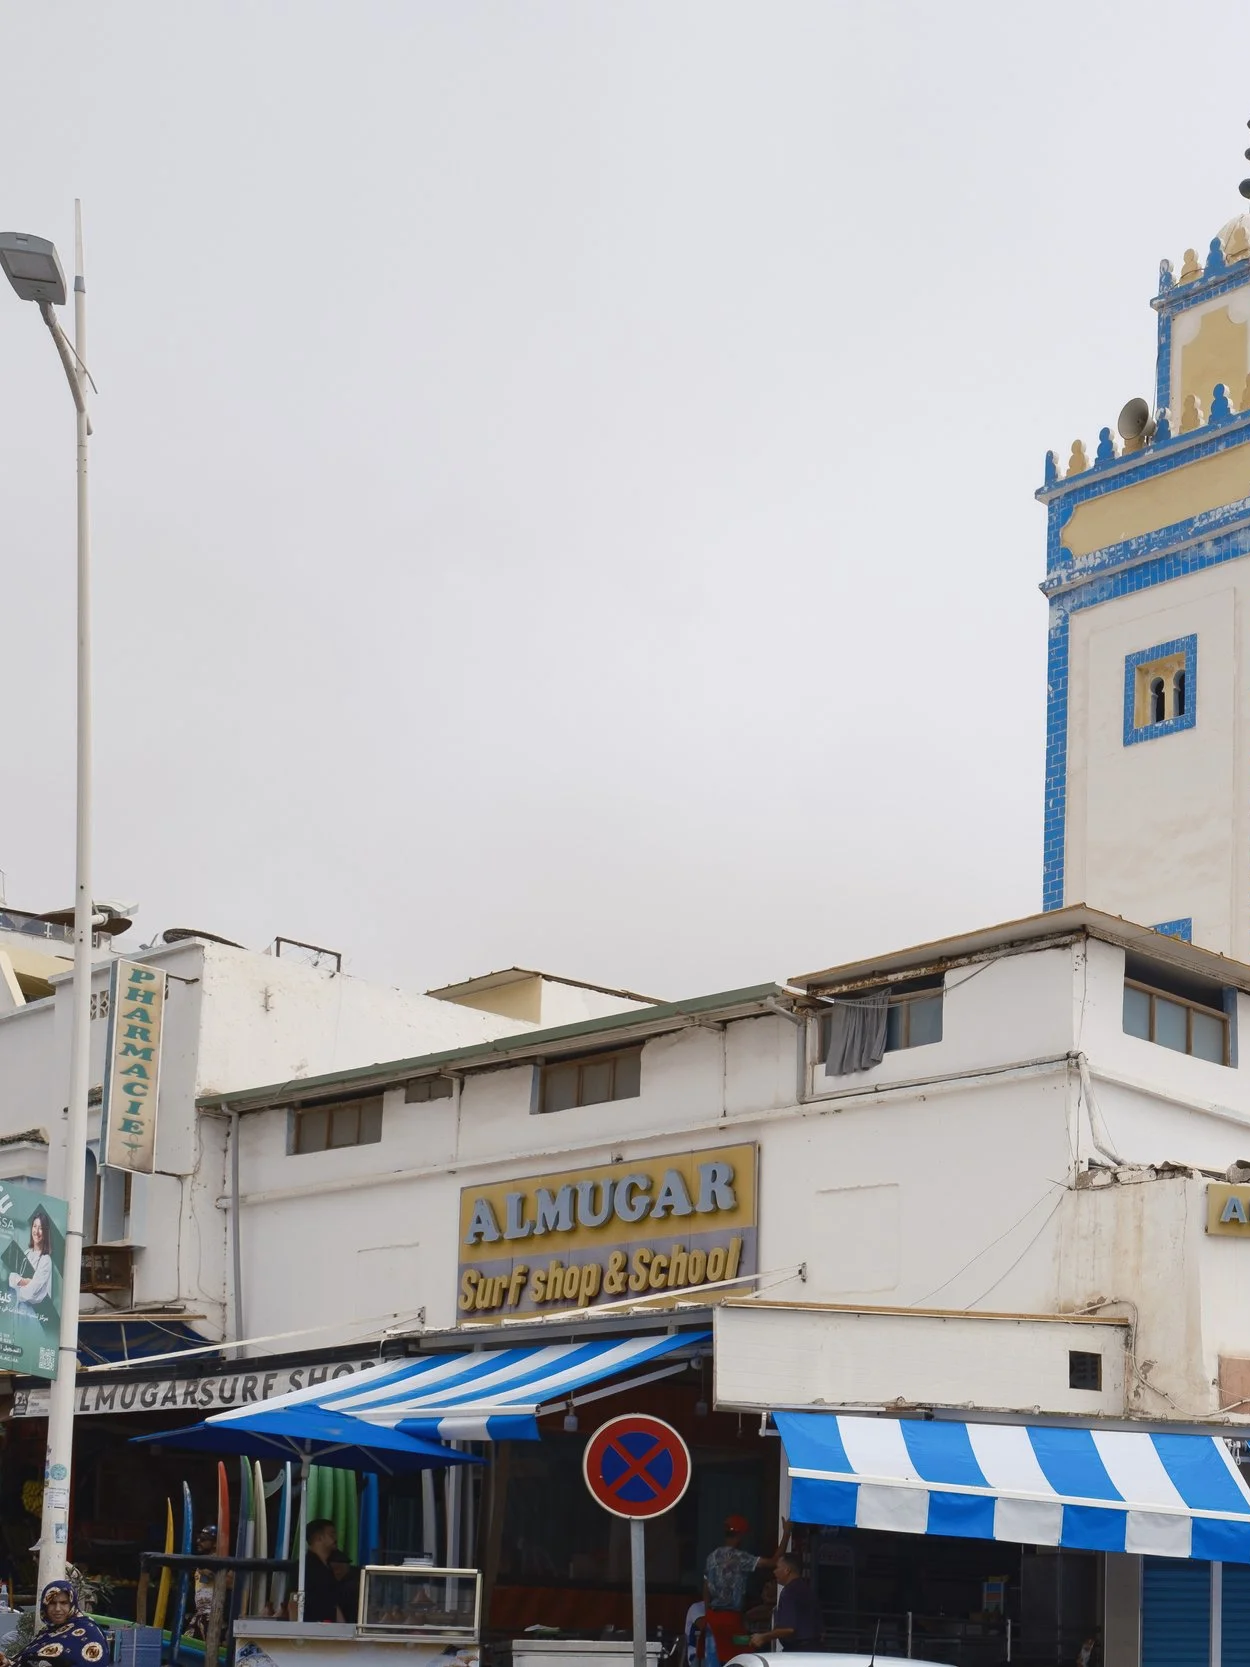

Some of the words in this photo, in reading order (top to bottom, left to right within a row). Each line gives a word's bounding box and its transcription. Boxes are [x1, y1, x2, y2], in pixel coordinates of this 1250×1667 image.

[118, 968, 156, 1135] PHARMACIE
[464, 1161, 736, 1245] ALMUGAR
[459, 1264, 529, 1312] Surf
[529, 1259, 602, 1307] shop
[74, 1380, 198, 1412] LMUGAR
